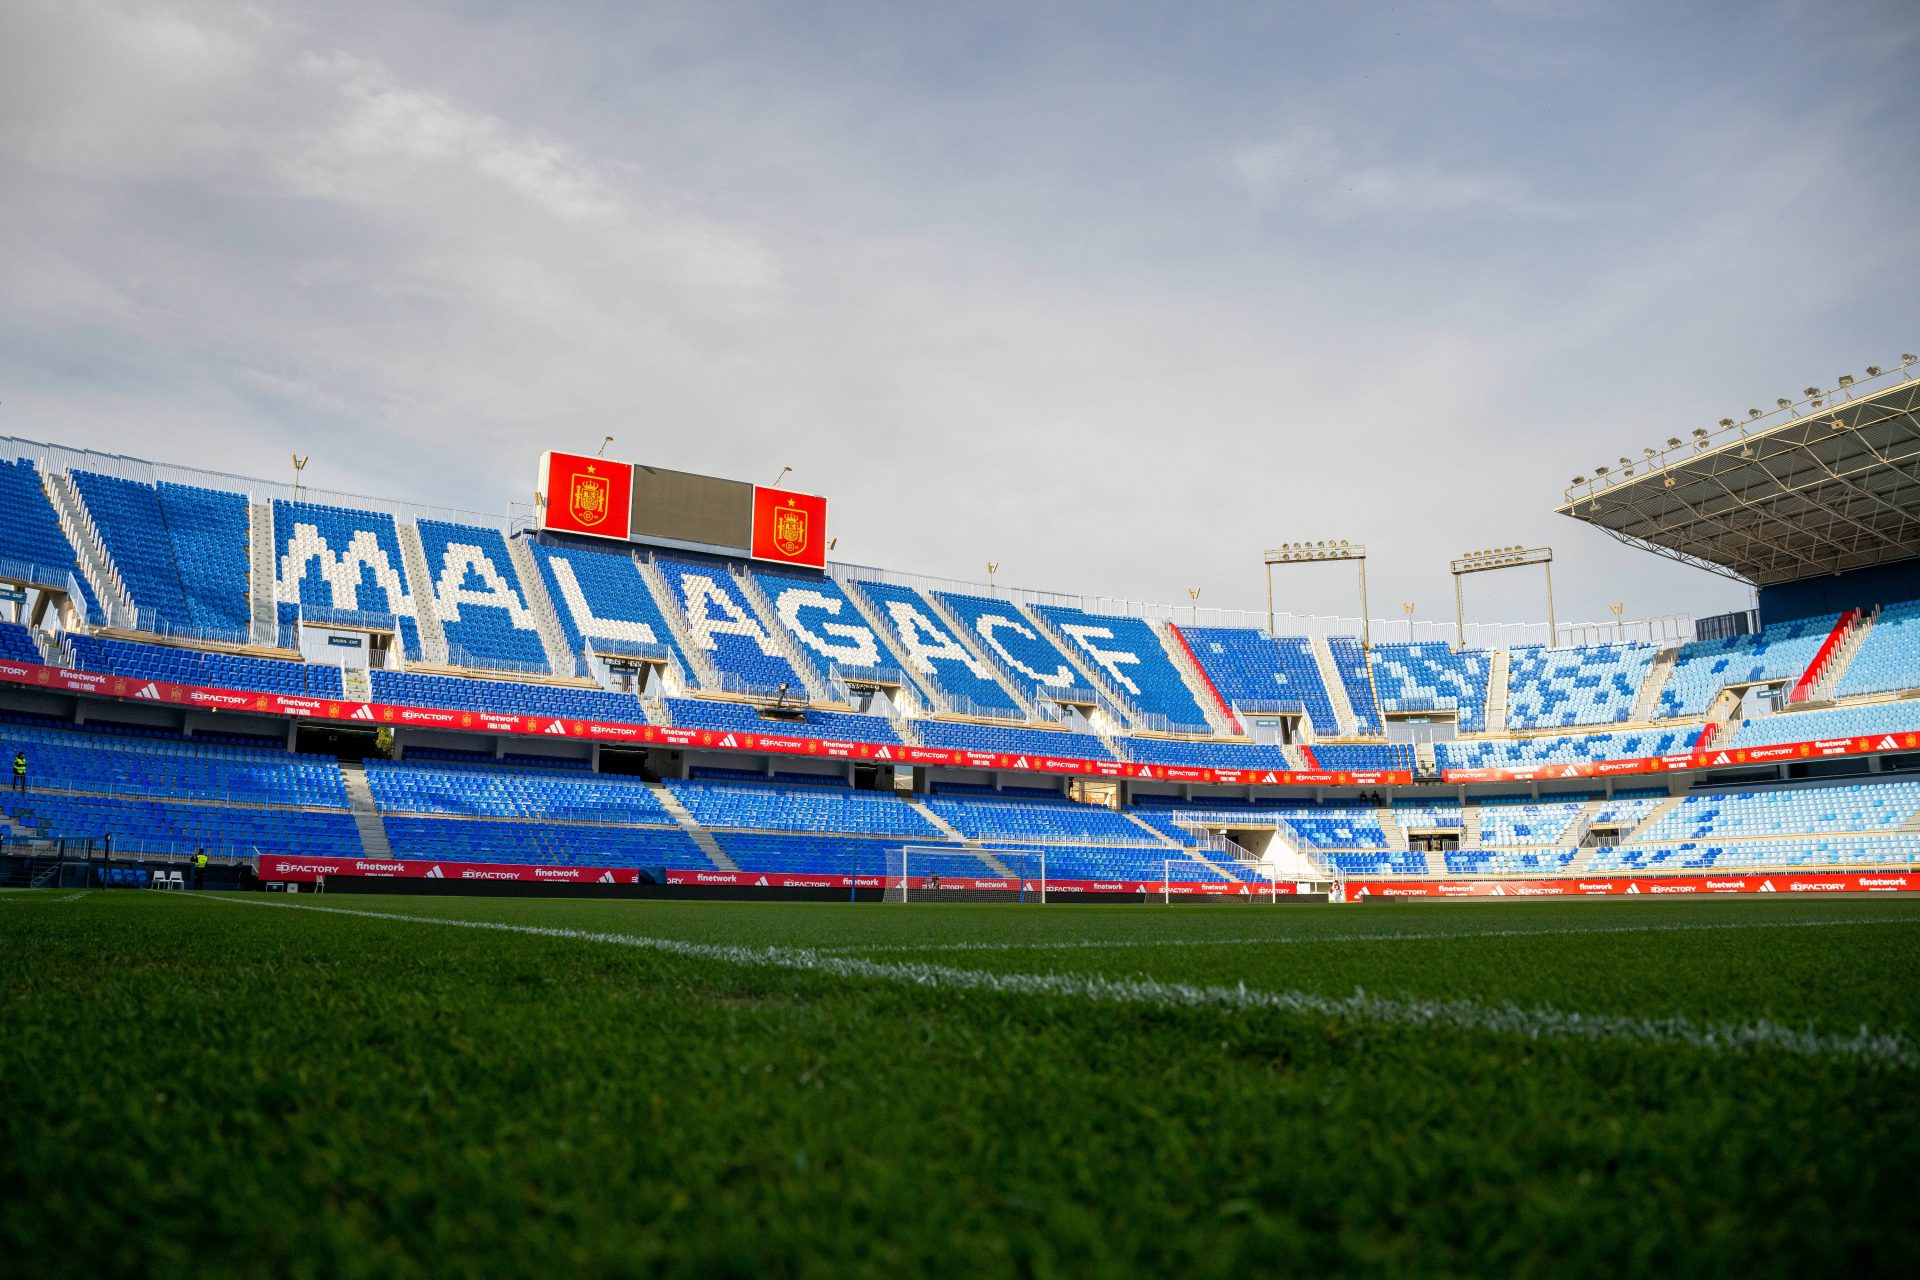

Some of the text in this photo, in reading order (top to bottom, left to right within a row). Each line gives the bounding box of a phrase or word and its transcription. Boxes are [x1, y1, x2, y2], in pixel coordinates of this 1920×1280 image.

[60, 669, 106, 684] finetwork
[277, 697, 320, 709] finetwork
[480, 714, 519, 723] finetwork
[661, 728, 696, 737] finetwork
[823, 741, 854, 749] finetwork
[1815, 739, 1851, 748] finetwork
[967, 752, 996, 760] finetwork
[1662, 755, 1693, 763] finetwork
[356, 861, 404, 872] finetwork
[535, 868, 579, 877] finetwork
[697, 873, 737, 883] finetwork
[1859, 877, 1907, 887] finetwork
[975, 880, 1008, 889] finetwork
[1093, 882, 1123, 890] finetwork
[1579, 882, 1613, 891] finetwork
[1706, 880, 1745, 889] finetwork
